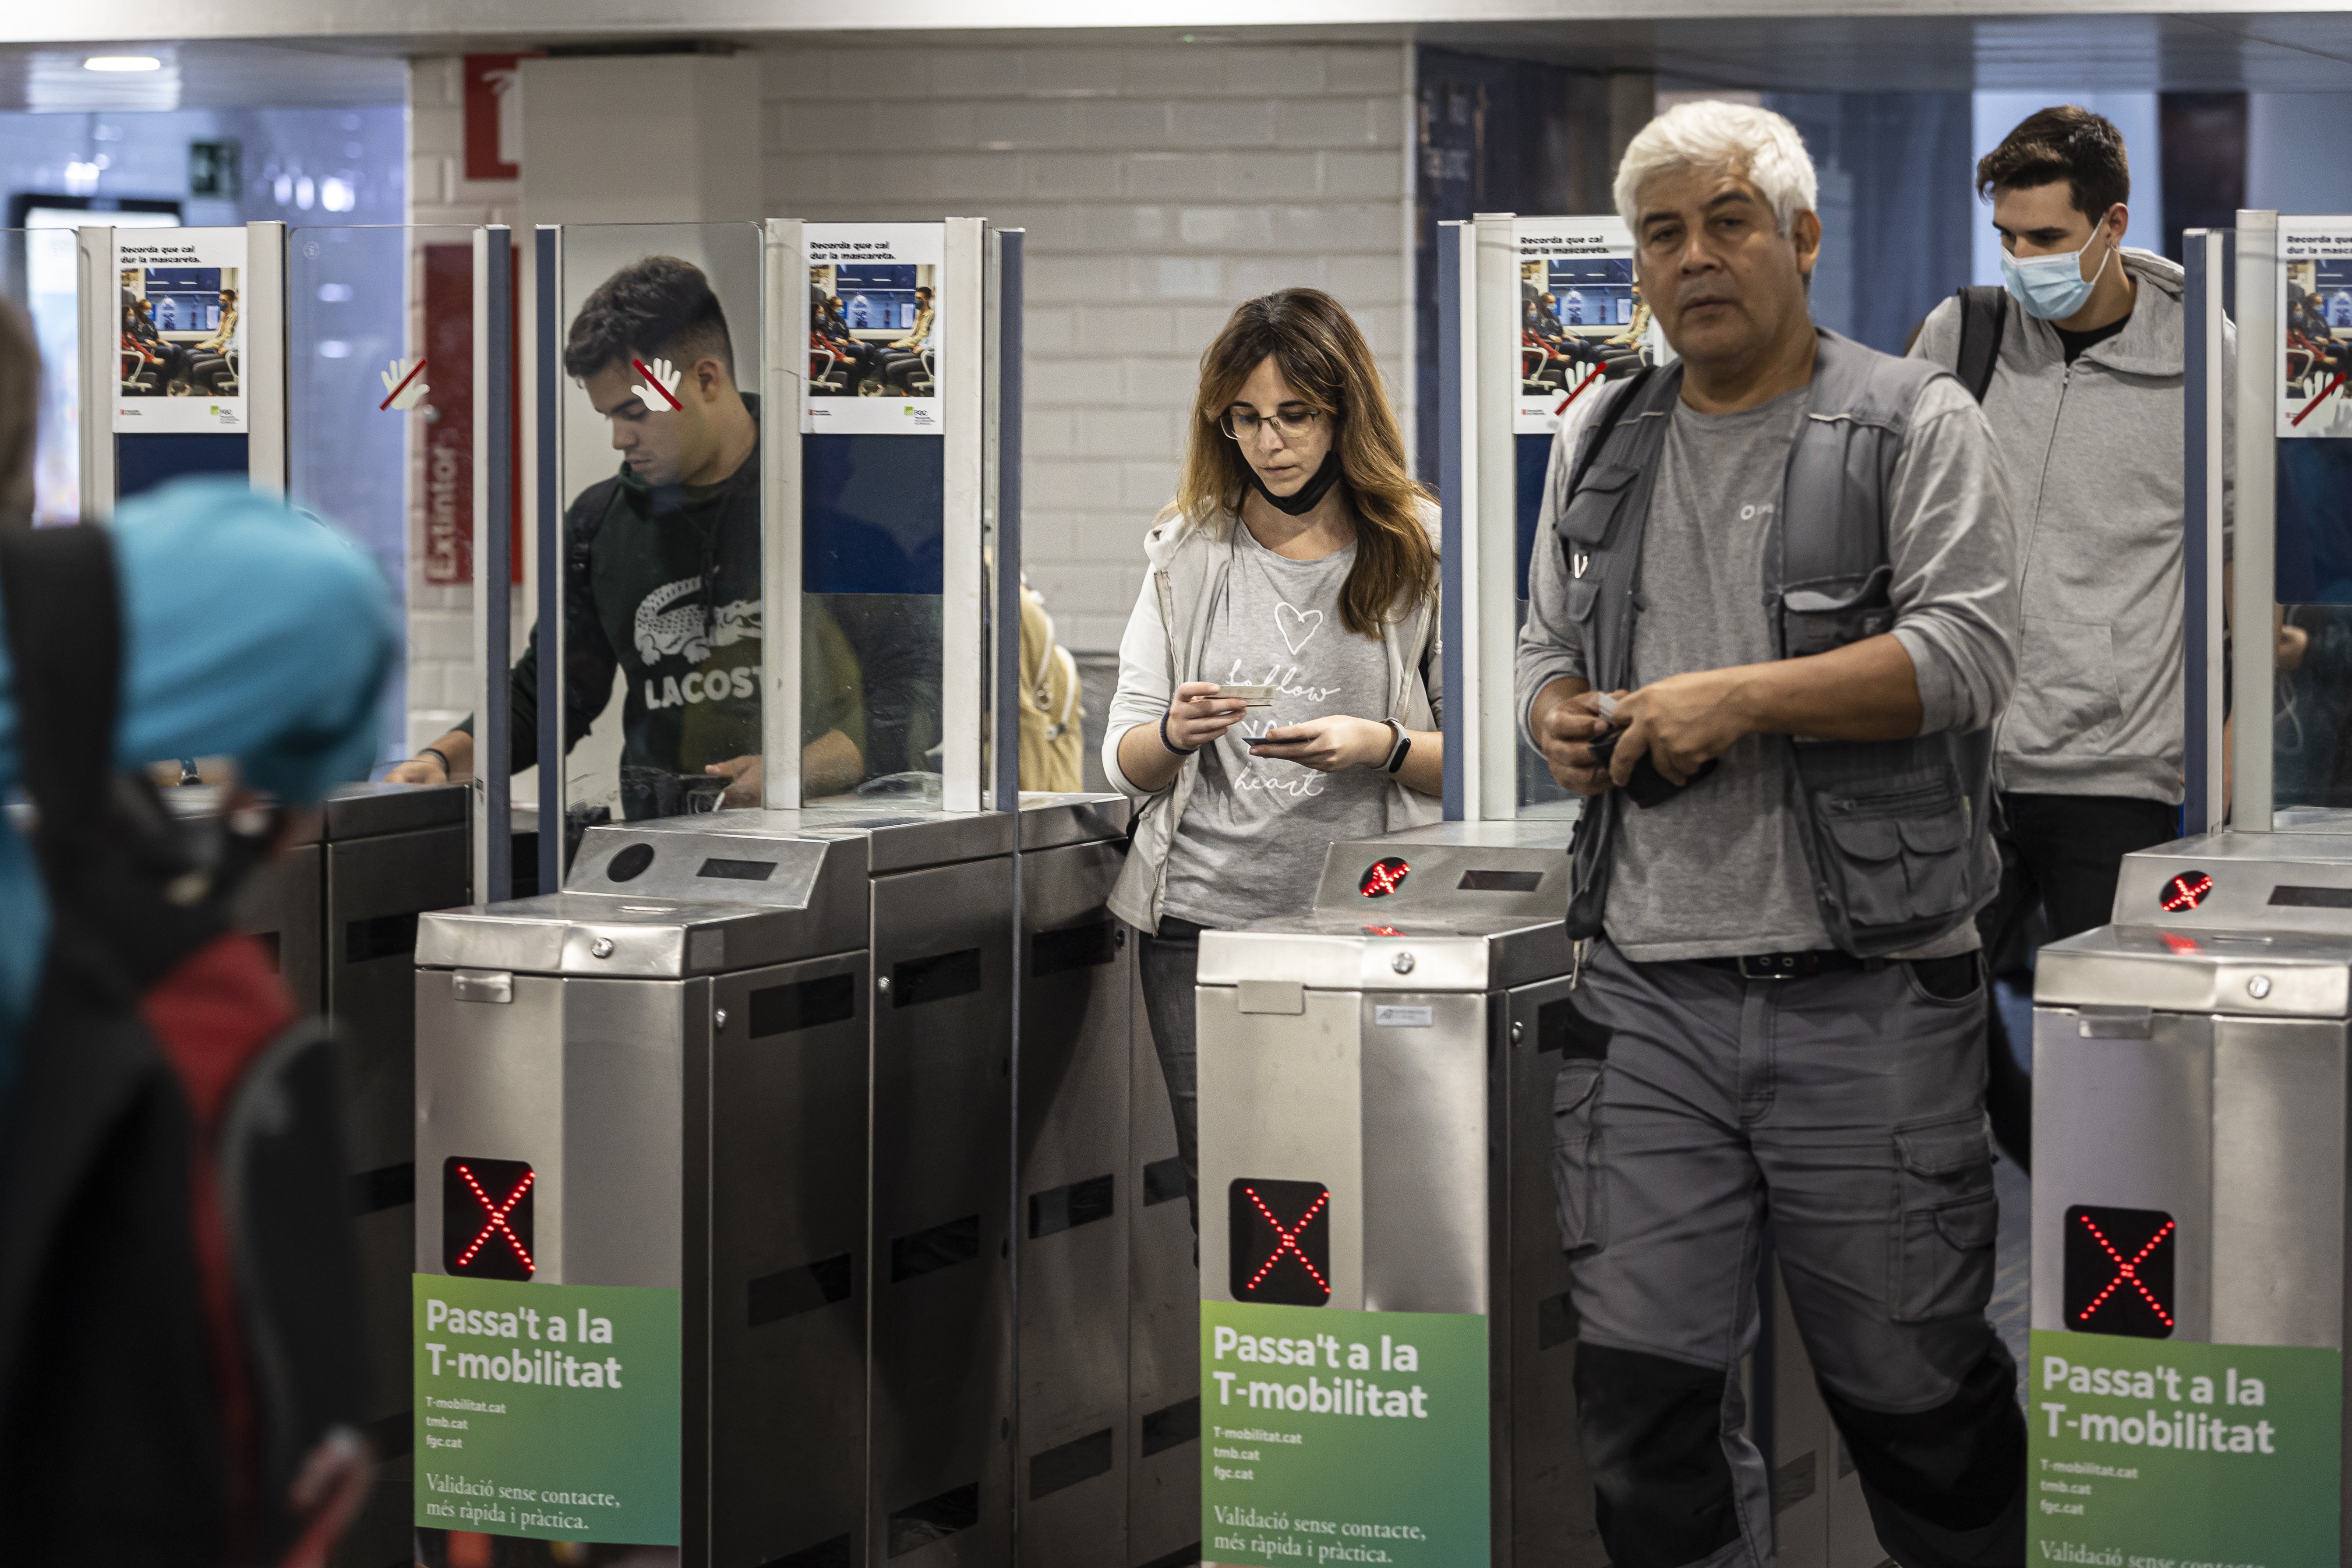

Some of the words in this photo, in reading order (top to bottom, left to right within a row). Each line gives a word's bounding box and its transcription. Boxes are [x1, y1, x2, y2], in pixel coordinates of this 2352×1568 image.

[875, 240, 890, 249] cal
[1519, 247, 1539, 255] dur
[1540, 246, 1550, 254] la
[1566, 237, 1586, 245] que
[1588, 235, 1603, 243] cal
[810, 251, 827, 260] dur
[830, 251, 839, 260] la
[1234, 761, 1328, 797] heart
[427, 1299, 540, 1340] Passa't
[547, 1316, 566, 1342] a
[578, 1308, 612, 1343] la
[1215, 1326, 1339, 1368] Passa't
[1348, 1343, 1369, 1370] a
[1381, 1335, 1418, 1371] la
[425, 1343, 622, 1388] T-mobilitat
[1212, 1371, 1427, 1418] T-mobilitat
[2043, 1356, 2182, 1401] Passa't
[2190, 1377, 2213, 1404] a
[2226, 1368, 2264, 1406] la
[425, 1396, 506, 1413] T-mobilitat.cat
[426, 1416, 468, 1430] tmb.cat
[1213, 1426, 1302, 1444] T-mobilitat.cat
[2041, 1402, 2274, 1453] T-mobilitat
[426, 1435, 462, 1448] fgc.cat
[1213, 1447, 1260, 1461] tmb.cat
[1214, 1465, 1254, 1480] fgc.cat
[426, 1473, 494, 1496] Validació
[499, 1487, 537, 1501] sense
[541, 1491, 620, 1507] contacte,
[427, 1500, 455, 1516] més
[460, 1501, 505, 1526] ràpida
[511, 1507, 515, 1523] i
[521, 1508, 588, 1530] pràctica.
[1214, 1505, 1289, 1529] Validació
[1294, 1519, 1336, 1534] sense
[1341, 1523, 1426, 1540] contacte,
[1215, 1533, 1245, 1550] més
[1251, 1534, 1301, 1559] ràpida
[1308, 1540, 1313, 1556] i
[1319, 1541, 1392, 1564] pràctica.
[2040, 1540, 2122, 1566] Validació
